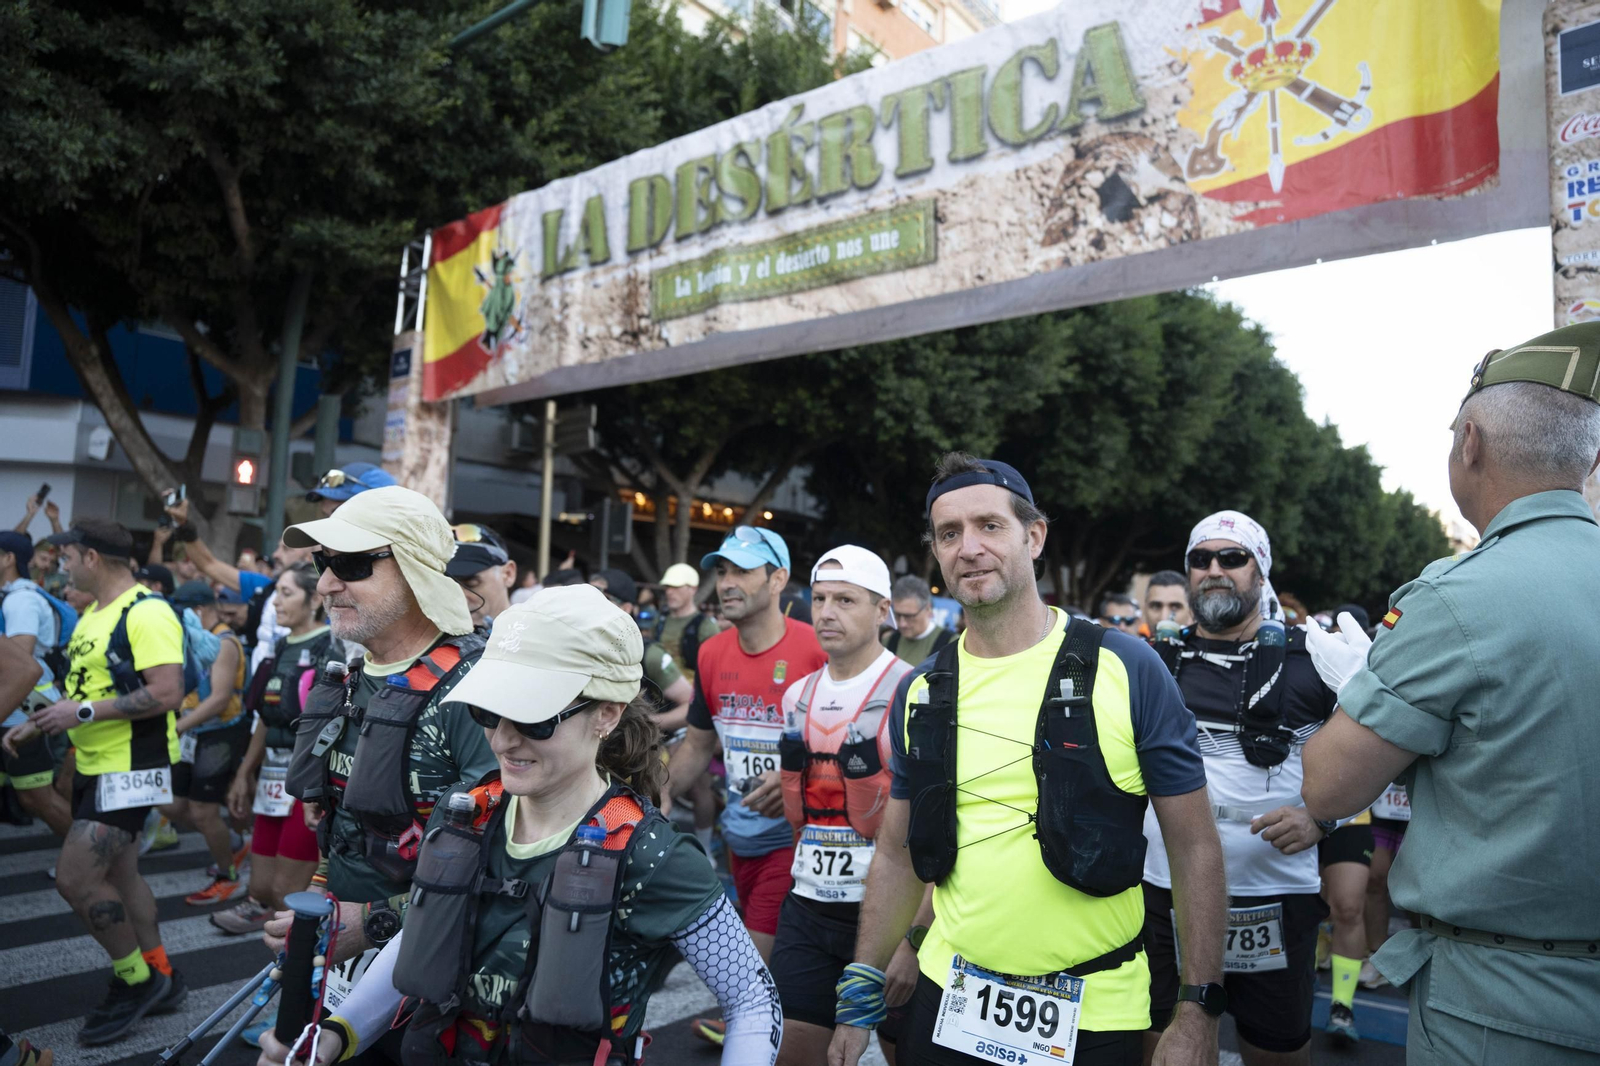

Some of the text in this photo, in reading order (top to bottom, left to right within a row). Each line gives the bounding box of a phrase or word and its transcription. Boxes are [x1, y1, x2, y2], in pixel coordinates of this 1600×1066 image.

[541, 20, 1147, 284] LA DESÉRTICA
[674, 275, 692, 298] La
[738, 264, 751, 287] y
[756, 254, 771, 279] el
[775, 243, 831, 277] desierto
[836, 235, 864, 261] nos
[870, 228, 901, 253] une
[743, 755, 776, 777] 169
[120, 771, 164, 791] 3646
[812, 849, 854, 876] 372
[1226, 925, 1271, 951] 783
[1224, 961, 1249, 970] sisa
[976, 984, 1060, 1039] 1599
[1032, 1042, 1050, 1053] INGO
